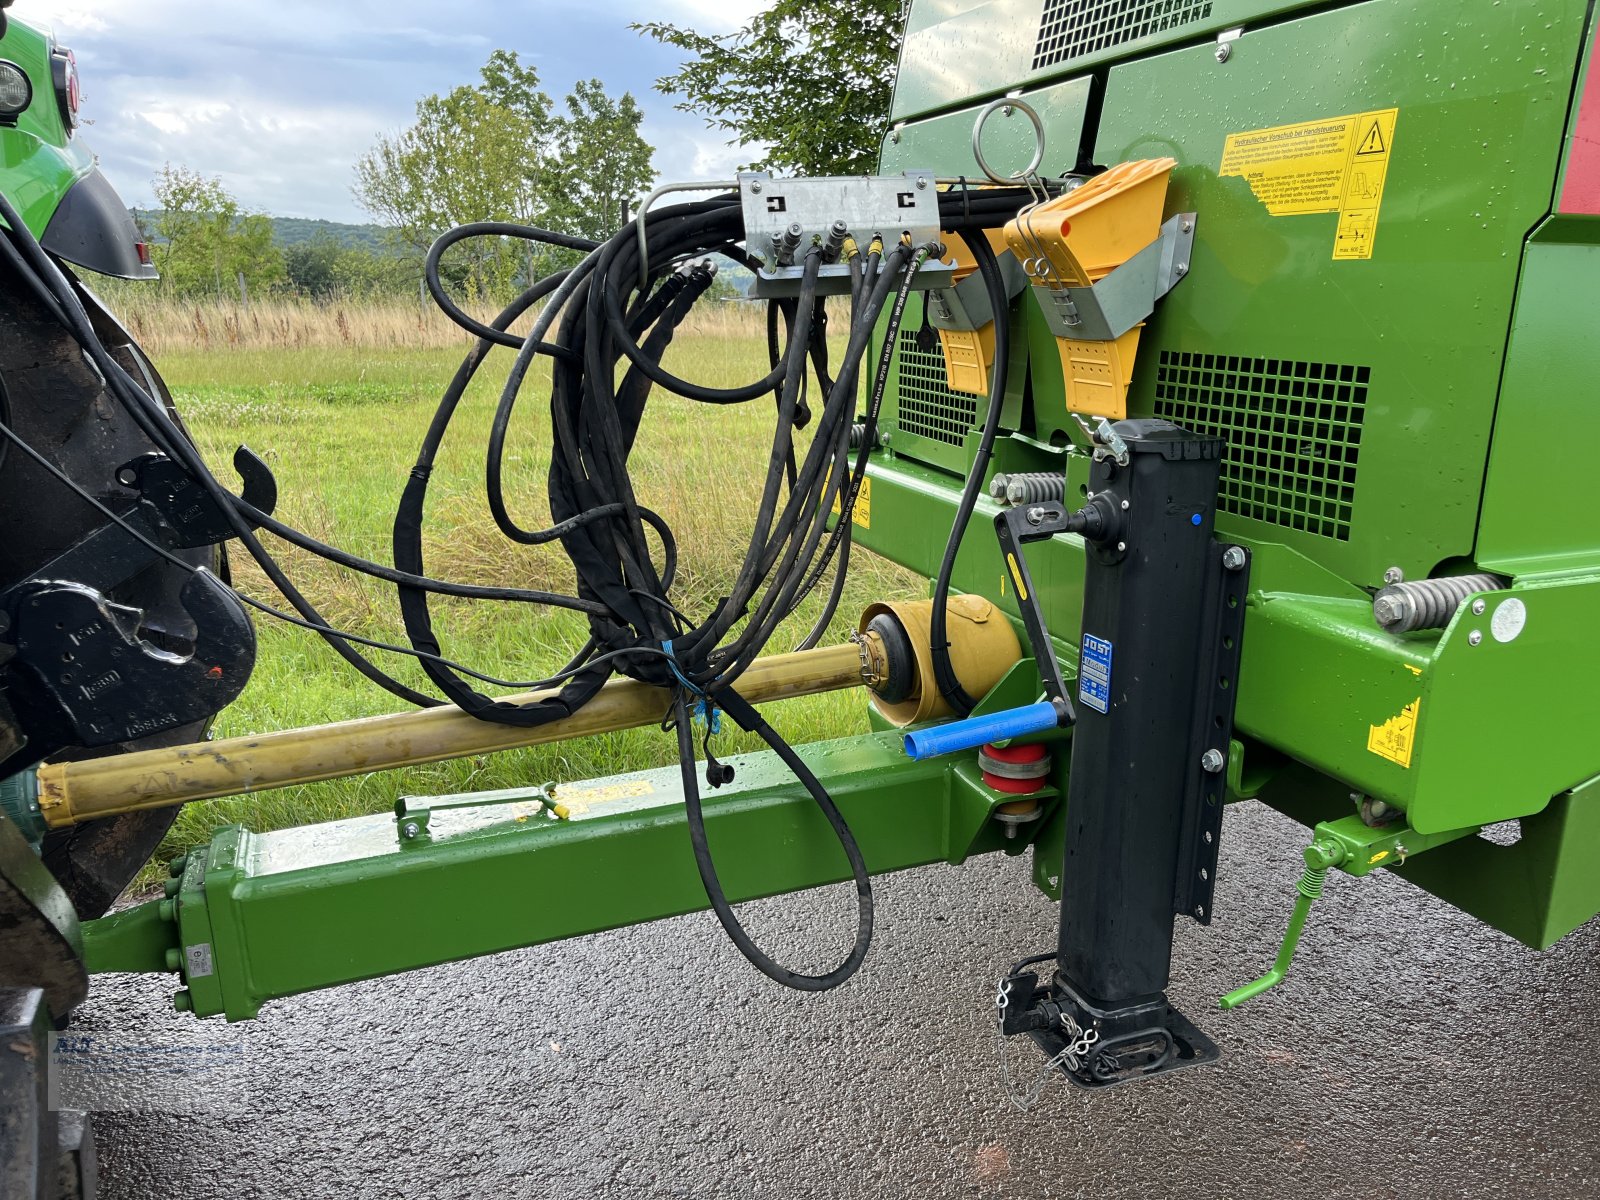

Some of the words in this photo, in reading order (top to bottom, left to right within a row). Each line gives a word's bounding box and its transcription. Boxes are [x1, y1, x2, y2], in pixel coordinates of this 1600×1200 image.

[1235, 136, 1268, 146] Hydraulischer
[1269, 132, 1294, 141] Vorschub
[1294, 129, 1303, 137] bei
[1303, 124, 1346, 136] Handsteuerung
[894, 307, 901, 316] WP
[900, 285, 908, 298] BAR
[1084, 638, 1110, 656] JOST
